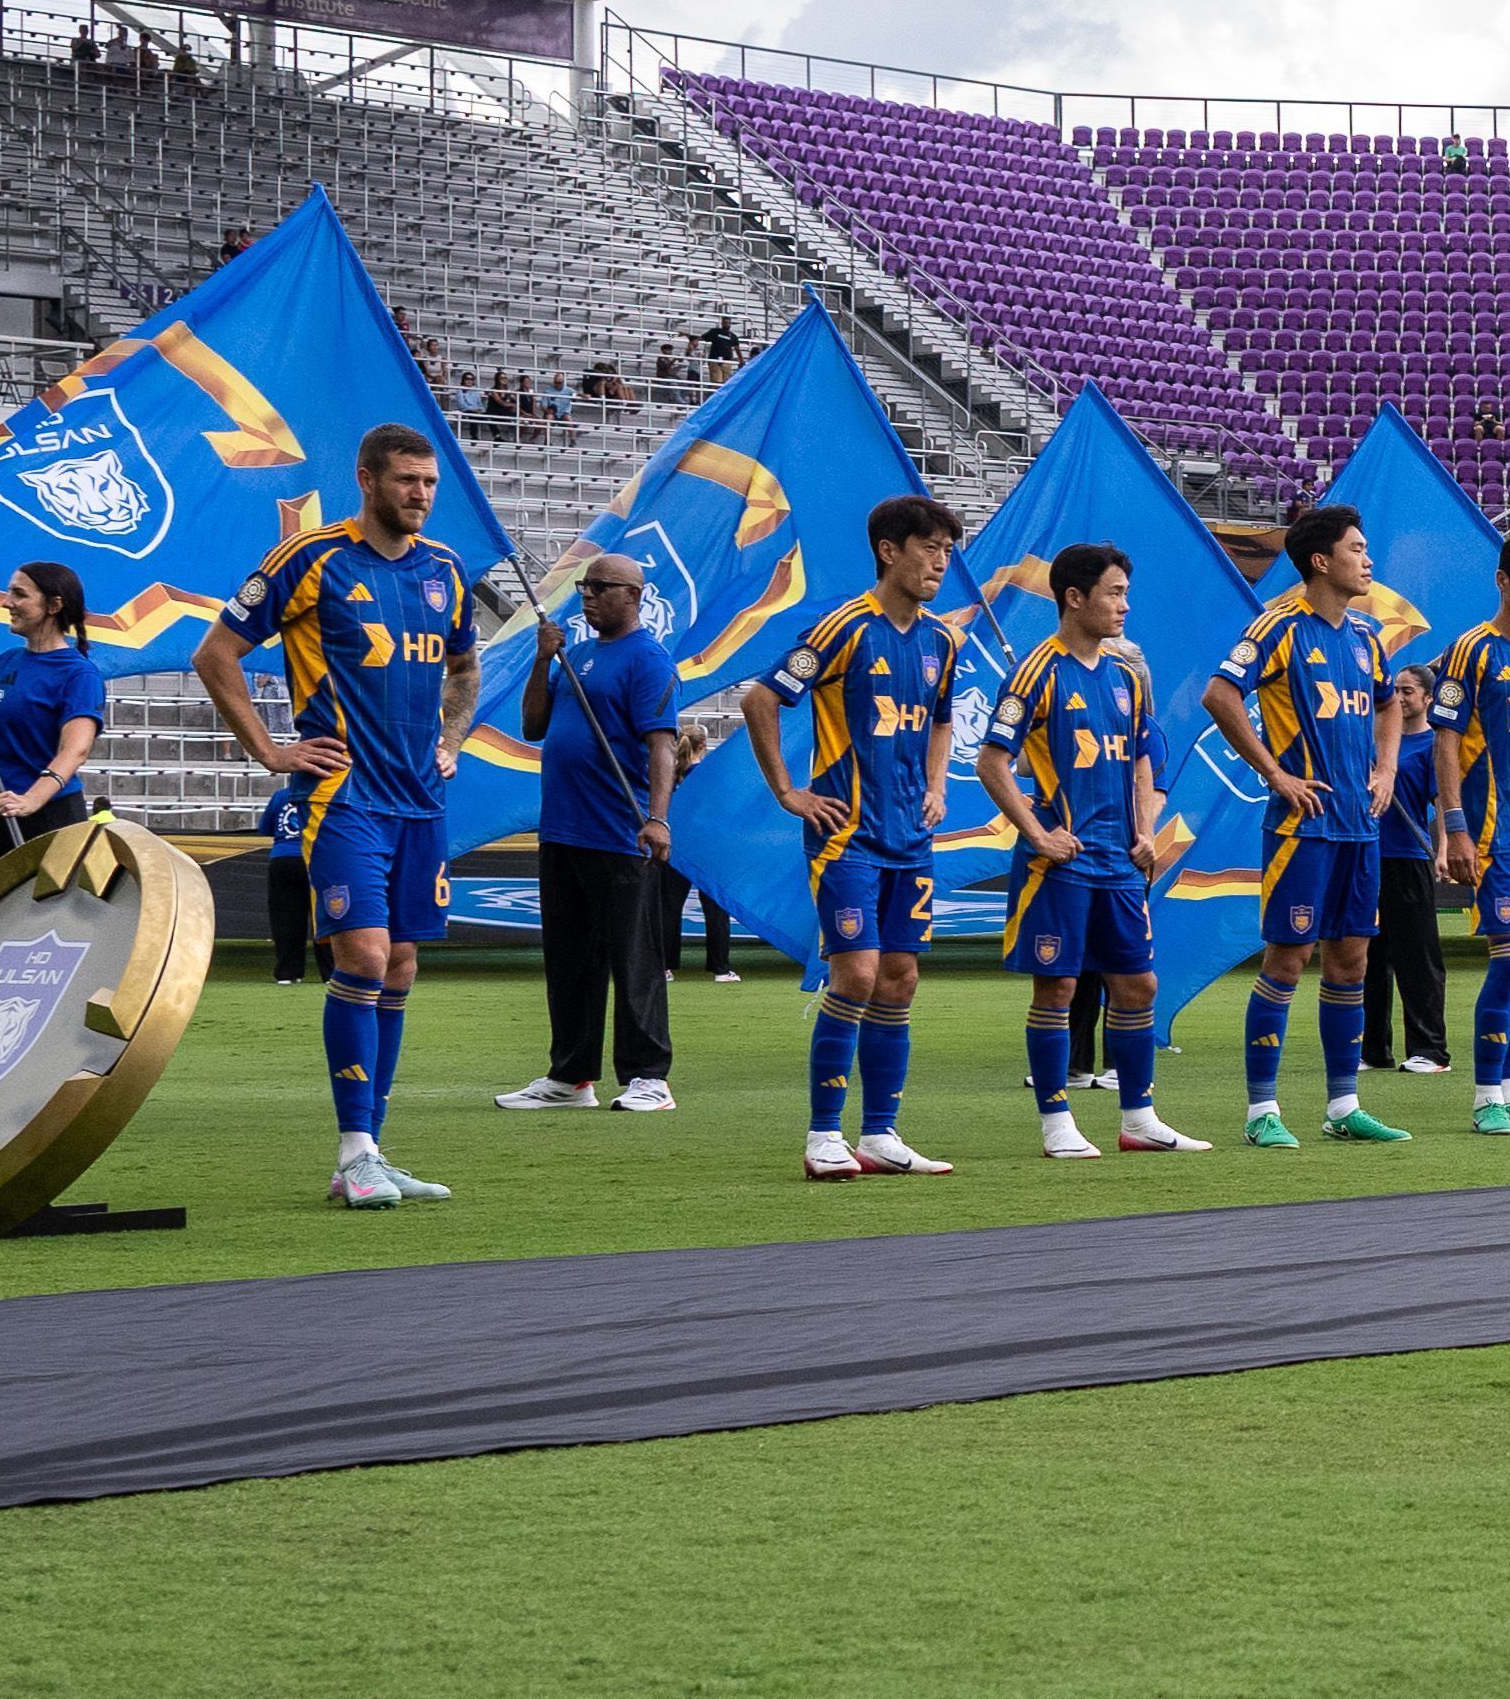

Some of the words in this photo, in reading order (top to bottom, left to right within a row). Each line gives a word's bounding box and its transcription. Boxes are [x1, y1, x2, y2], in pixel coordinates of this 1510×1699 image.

[402, 632, 445, 664] HD
[1342, 689, 1371, 717] HD
[435, 860, 450, 907] 6
[911, 877, 934, 920] 2
[25, 951, 52, 965] HD
